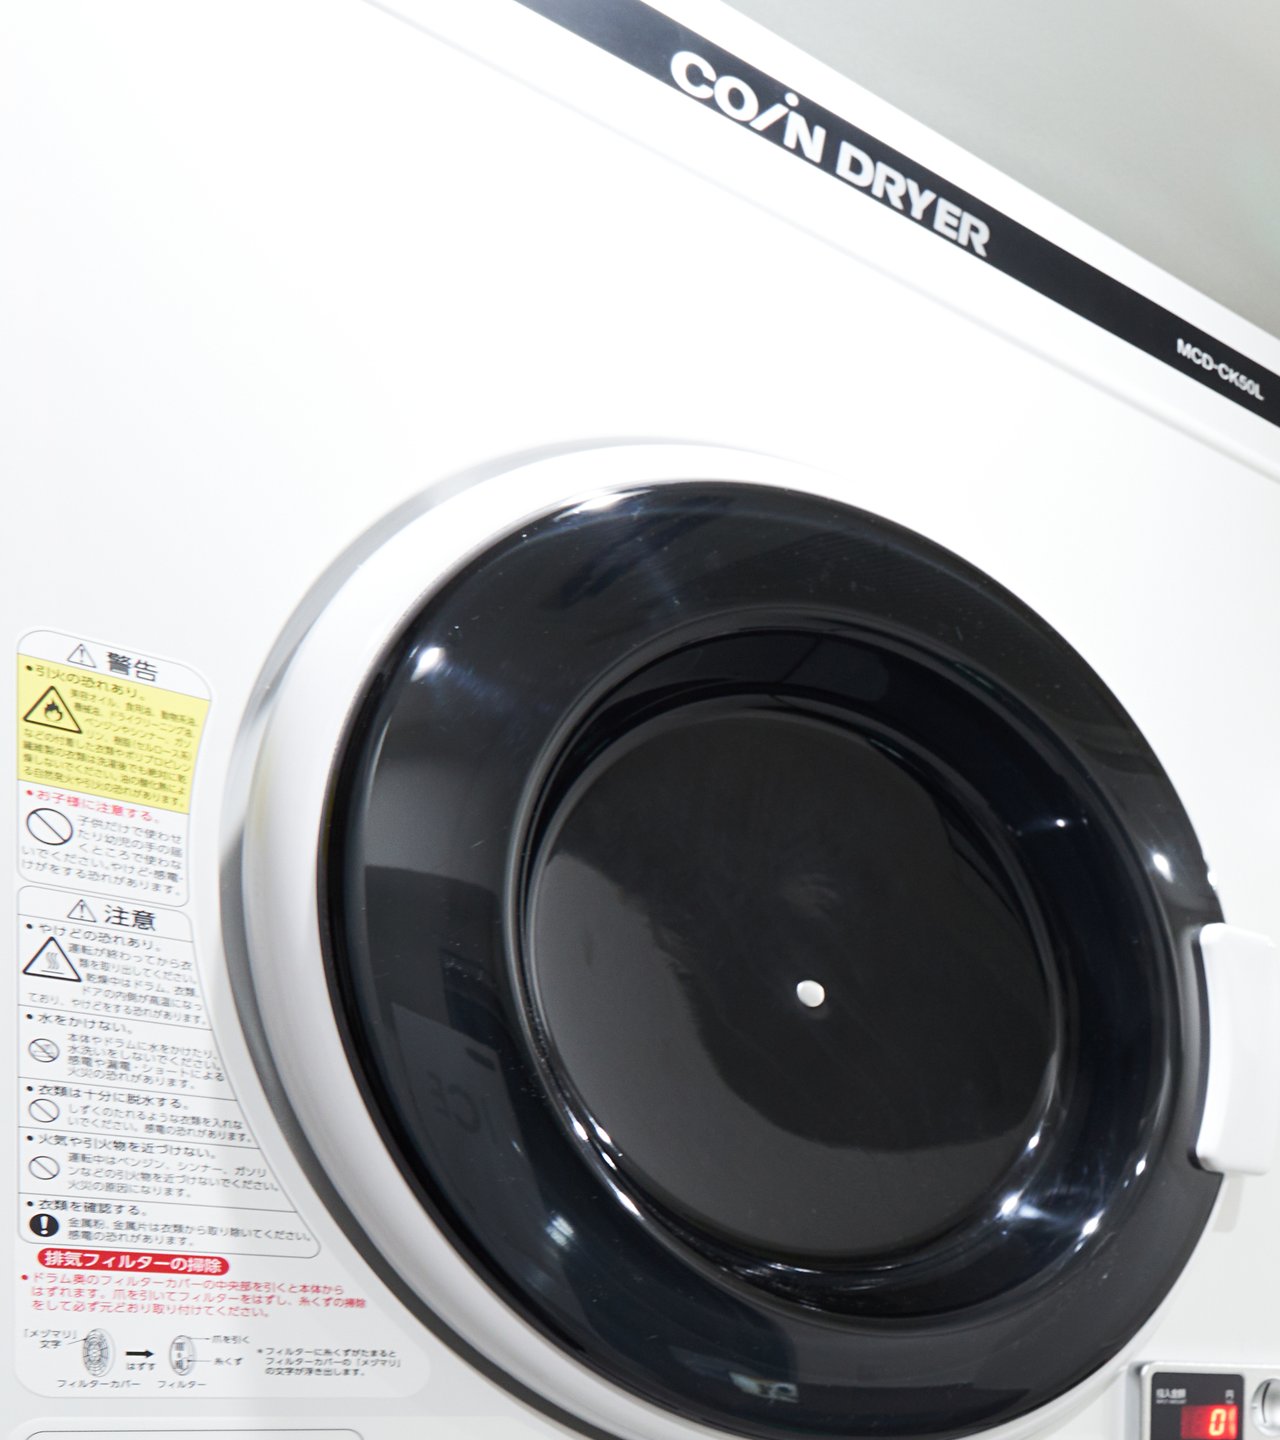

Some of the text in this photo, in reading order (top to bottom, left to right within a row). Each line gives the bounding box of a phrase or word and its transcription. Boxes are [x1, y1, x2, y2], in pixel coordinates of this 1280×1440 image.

[836, 140, 990, 257] DRYER
[1176, 338, 1264, 401] MCD-CK50L
[106, 651, 158, 682] 警告
[104, 904, 156, 932] 注意
[39, 923, 161, 952] やけどの恐れあり。
[37, 1013, 133, 1034] 水をかけない。
[38, 1085, 189, 1110] 衣類は十分に脱水する。
[38, 1134, 216, 1159] 火気や引火物を近づけない。
[38, 1200, 147, 1216] 衣類を確認する。
[44, 1251, 223, 1274] 排気フィルターの掃除
[57, 1379, 141, 1389] フィルターカバー
[157, 1380, 206, 1389] フィルター
